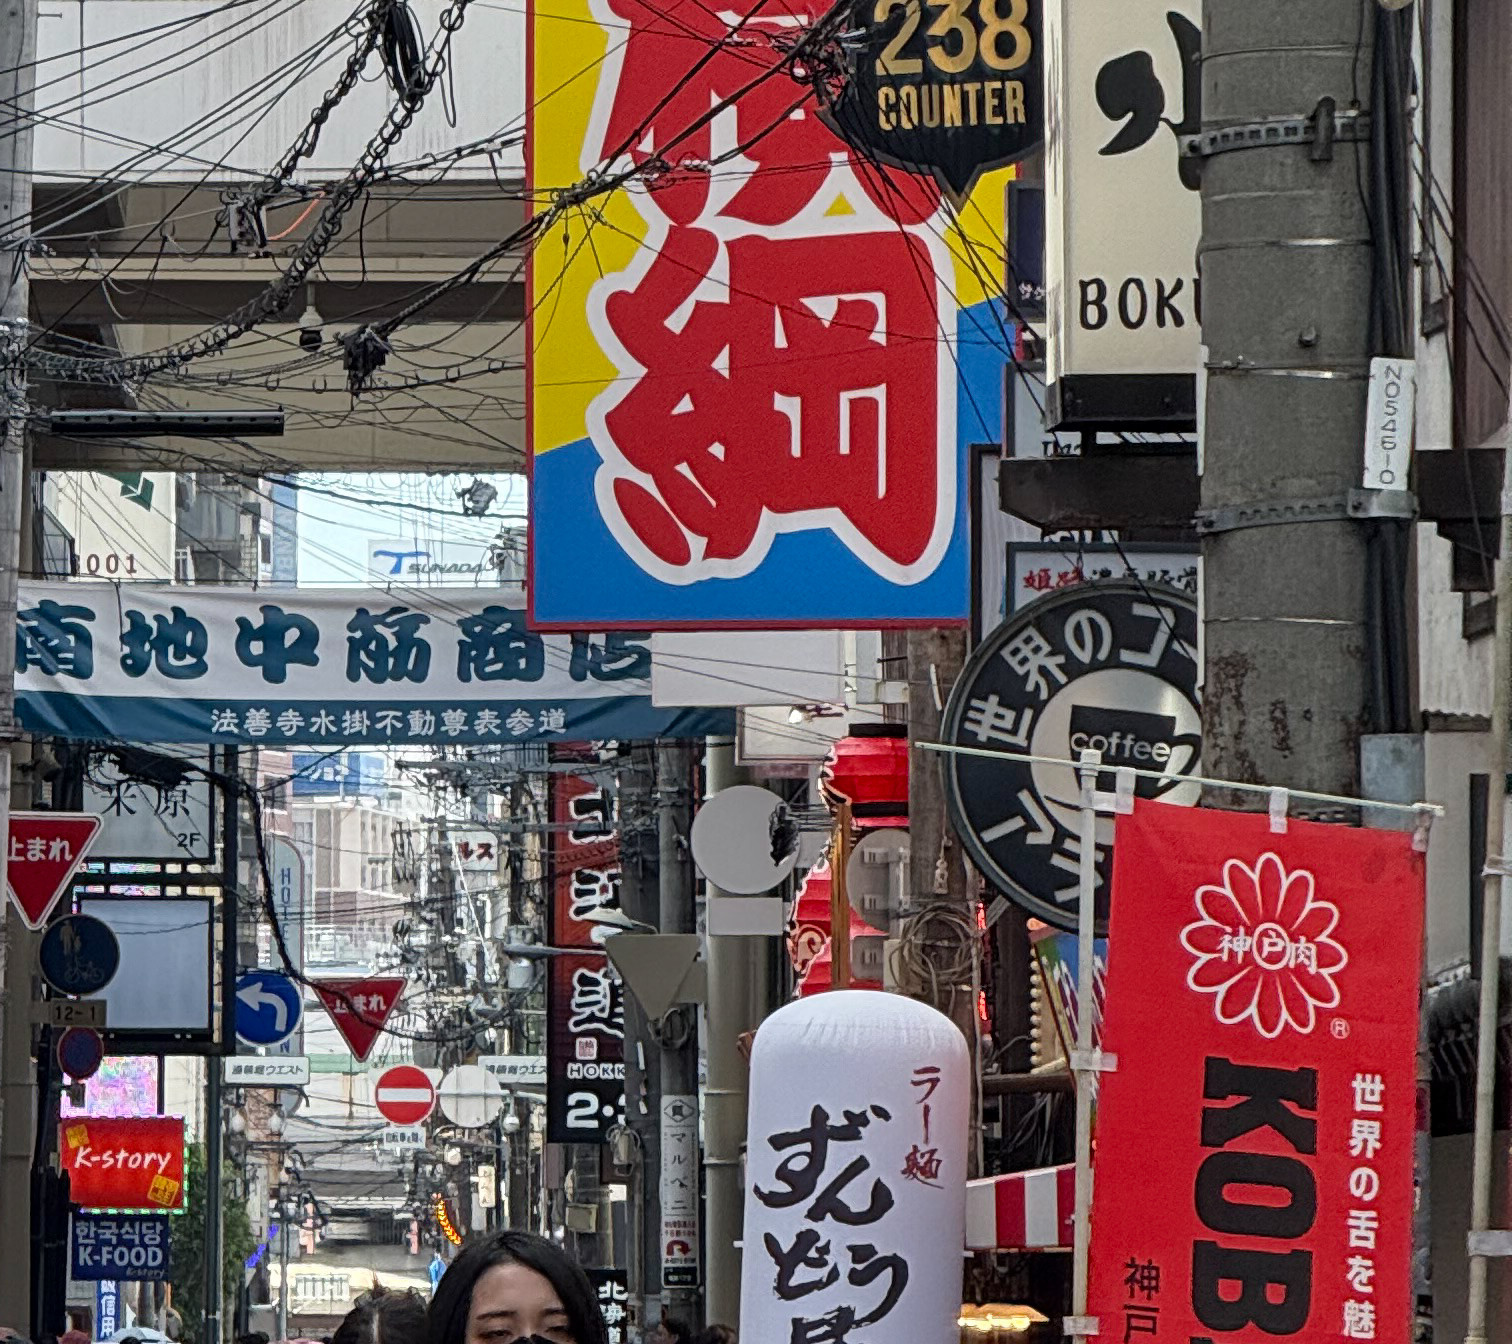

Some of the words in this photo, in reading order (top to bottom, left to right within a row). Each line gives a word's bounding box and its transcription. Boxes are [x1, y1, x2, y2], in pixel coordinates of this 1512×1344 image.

[878, 82, 1026, 130] COUNTER
[1079, 277, 1201, 330] BOK
[86, 552, 138, 575] 001
[211, 707, 568, 735] 法善寺水掛不動尊表参道
[1069, 726, 1171, 762] coffee
[177, 832, 202, 847] 2F
[1218, 924, 1319, 976] 神戸肉
[899, 1066, 945, 1190] ラー麺
[74, 1146, 172, 1175] K-story
[75, 1220, 165, 1246] 한국식당
[78, 1246, 164, 1267] K-FOOD
